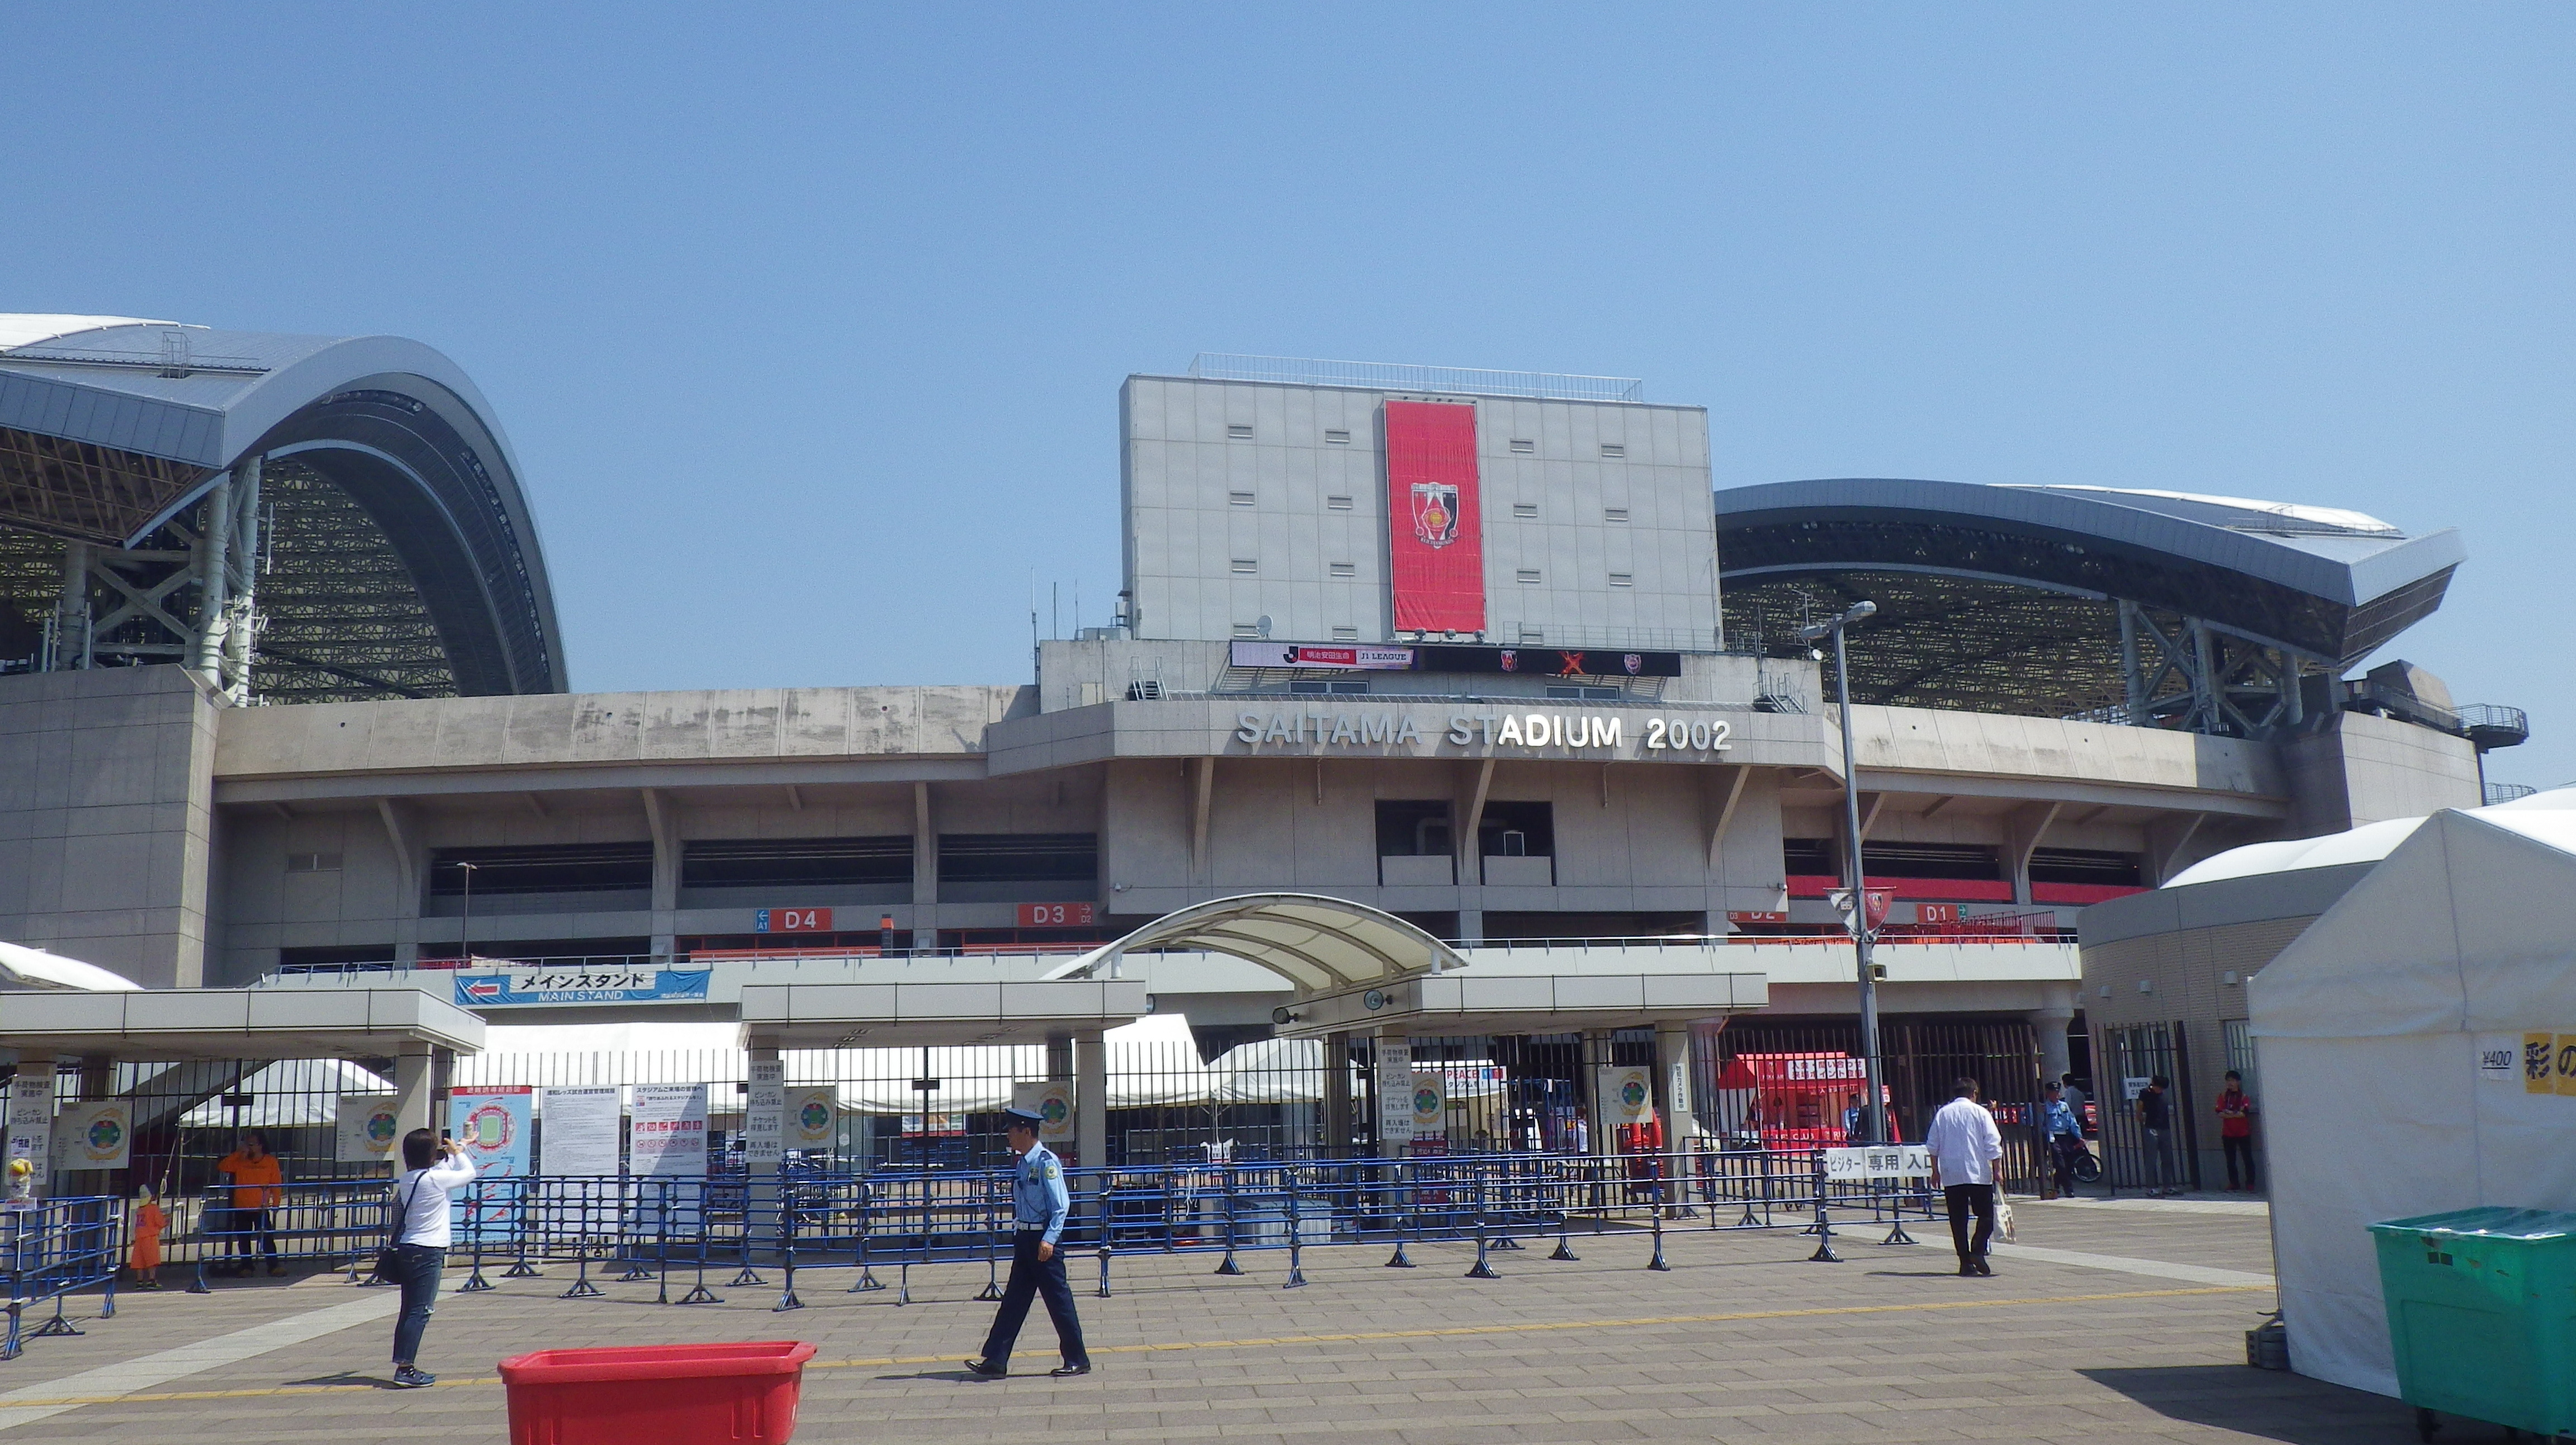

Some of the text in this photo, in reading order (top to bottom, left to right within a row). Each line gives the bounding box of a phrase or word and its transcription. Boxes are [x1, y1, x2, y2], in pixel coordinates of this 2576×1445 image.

[1307, 651, 1350, 660] 明治安田生命
[1237, 711, 1732, 750] SAITAMA STADIUM 2002
[522, 973, 646, 989] メインスタンド
[538, 991, 624, 1002] MAIN STAND
[2483, 1051, 2512, 1067] ¥400
[2526, 1042, 2576, 1079] 彩の
[1868, 1155, 1899, 1171] 専用
